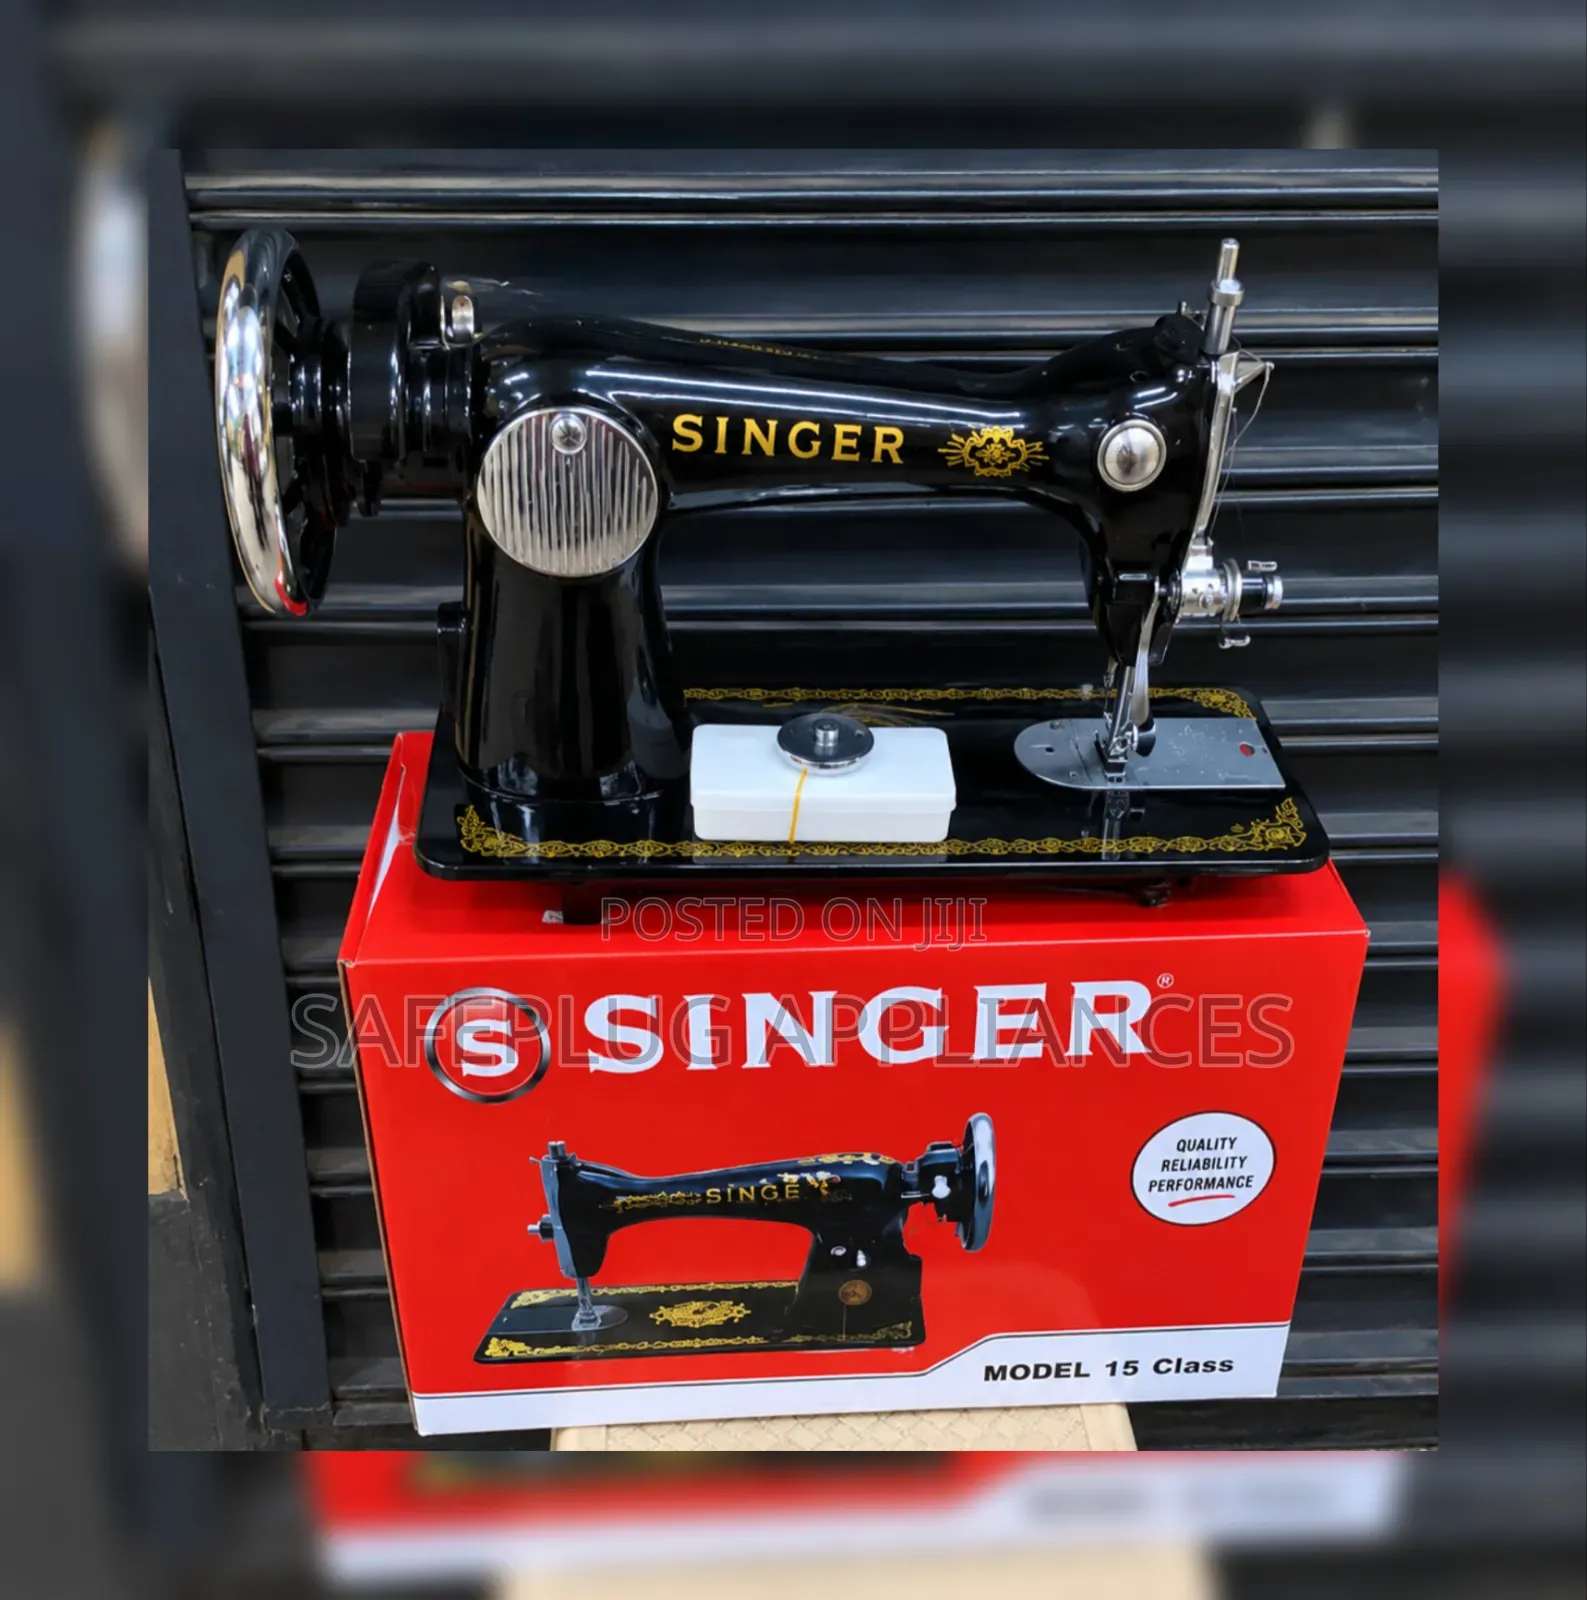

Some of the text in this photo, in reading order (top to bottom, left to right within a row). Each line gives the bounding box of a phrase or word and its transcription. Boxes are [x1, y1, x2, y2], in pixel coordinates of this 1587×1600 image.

[672, 413, 904, 464] SINGER
[584, 981, 1152, 1074] SINGER
[1176, 1137, 1238, 1152] QUALITY
[1161, 1156, 1248, 1172] RELIABILITY
[1148, 1175, 1254, 1193] PERFORMANCE
[983, 1358, 1235, 1382] MODEL 15 Class
